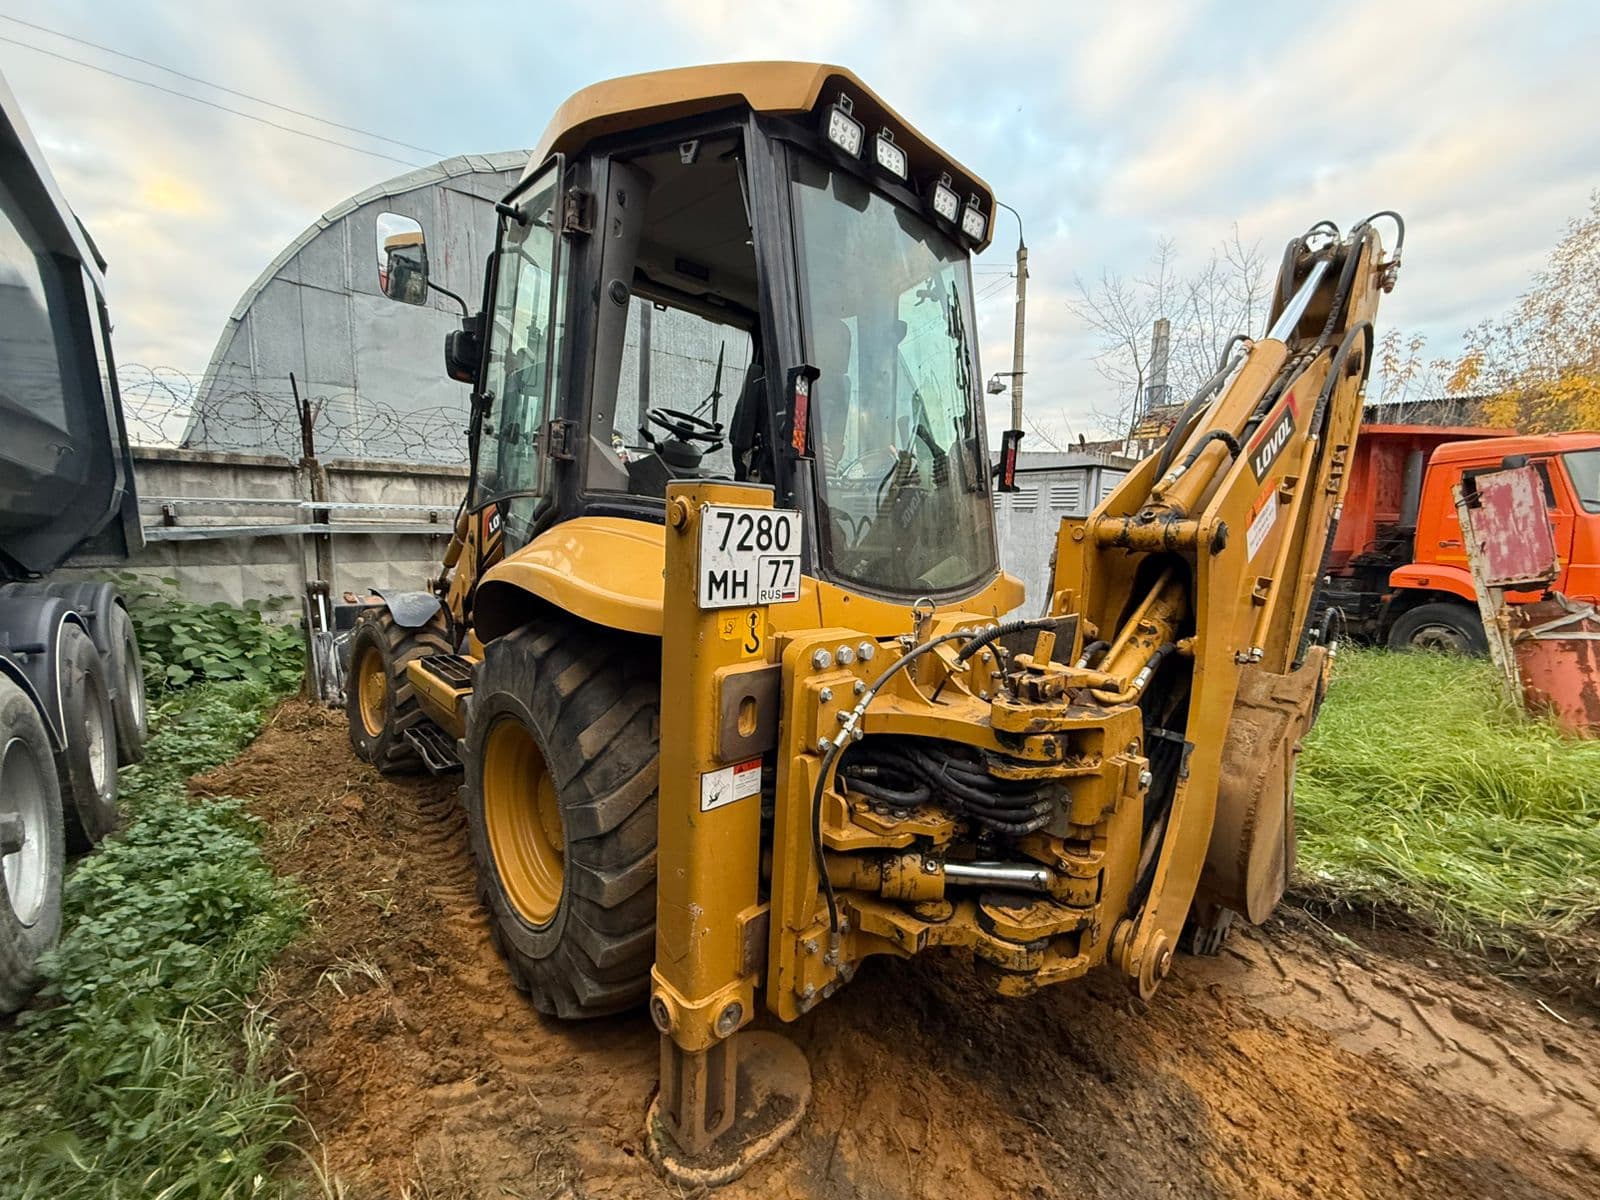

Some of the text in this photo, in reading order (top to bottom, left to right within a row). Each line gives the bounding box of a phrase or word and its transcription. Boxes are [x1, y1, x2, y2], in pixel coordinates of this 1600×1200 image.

[1256, 417, 1291, 477] LOVOL
[489, 513, 501, 533] LO
[717, 513, 790, 551] 7280
[768, 560, 794, 587] 77
[760, 590, 781, 601] RUS
